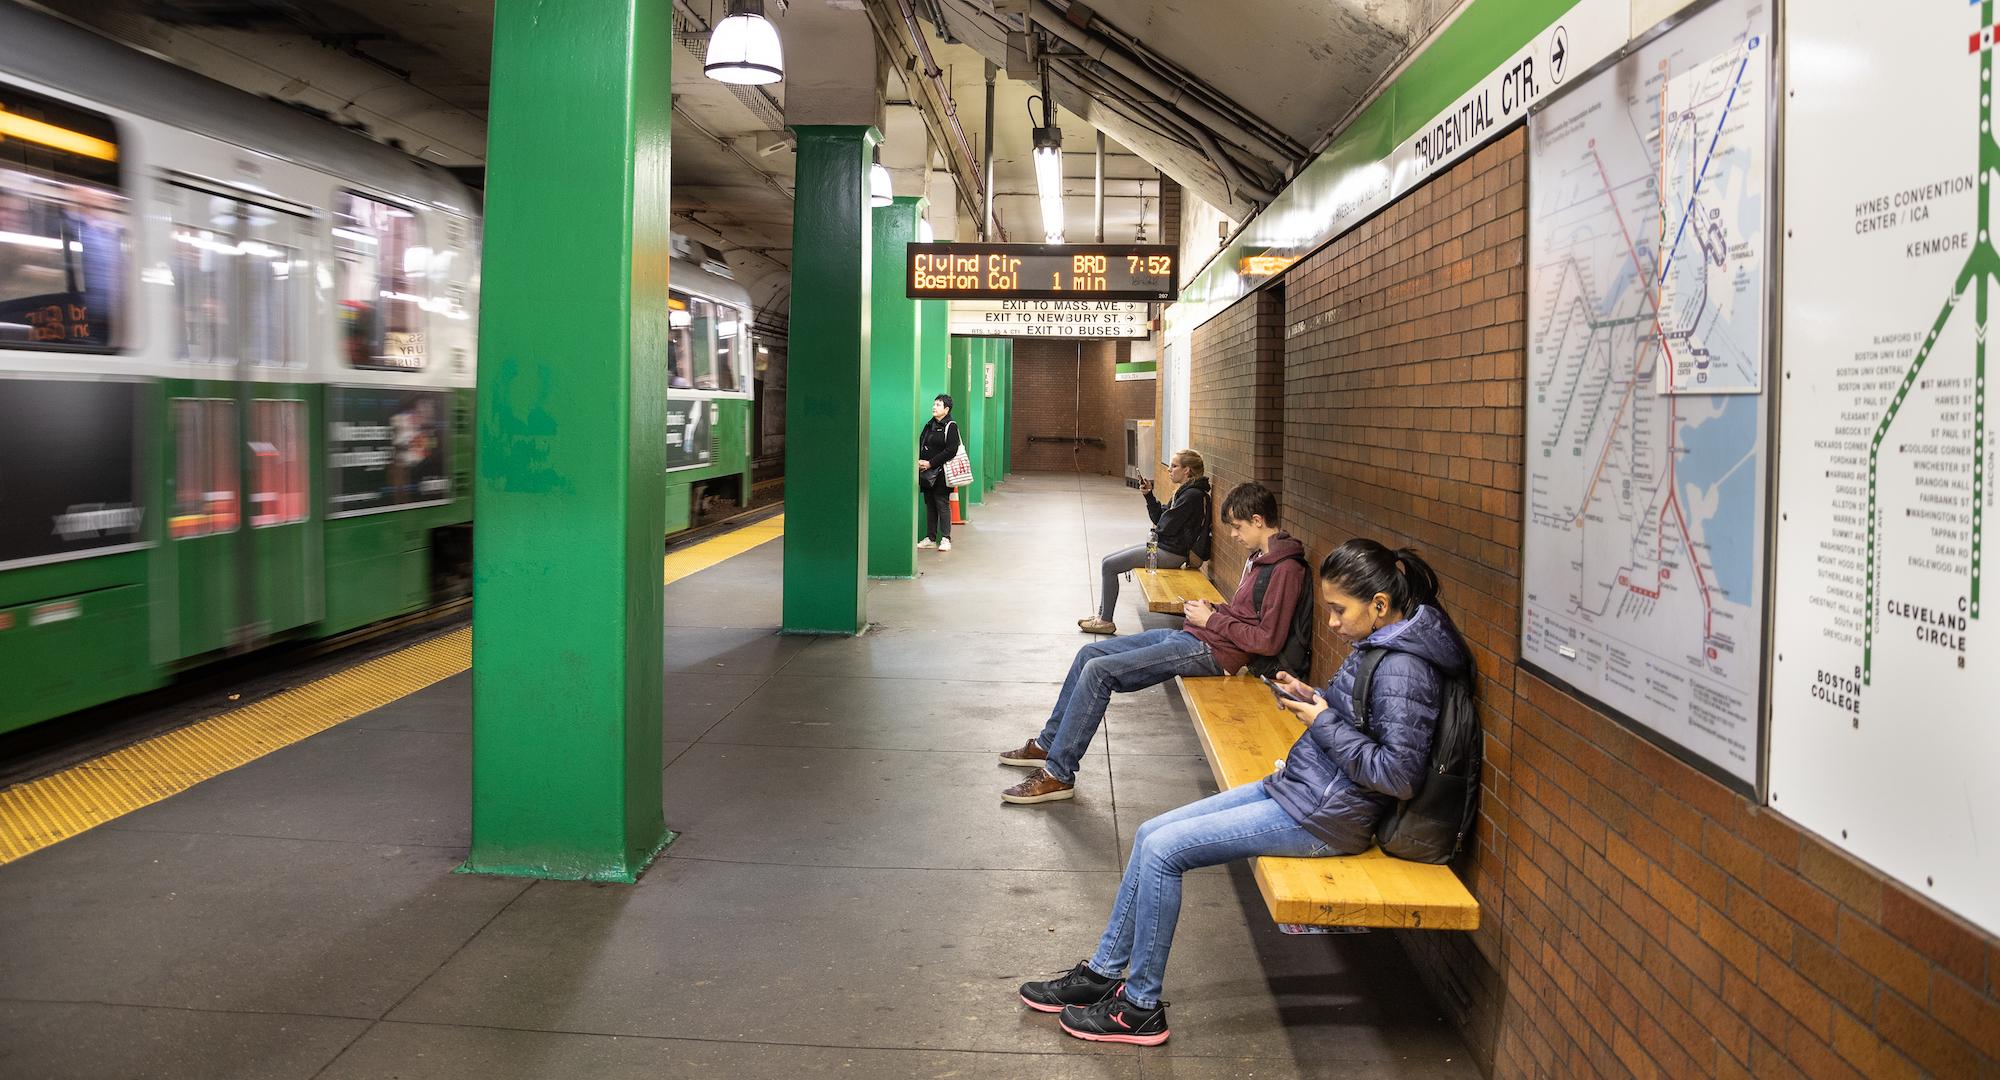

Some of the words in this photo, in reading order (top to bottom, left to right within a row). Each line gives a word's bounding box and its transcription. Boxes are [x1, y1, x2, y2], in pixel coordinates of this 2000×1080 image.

[1415, 89, 1493, 176] PRUDENTIAL
[1502, 56, 1539, 115] CTR.
[1855, 195, 1890, 217] HYNES
[1894, 174, 1974, 208] CONVENTION
[1855, 211, 1897, 235] CENTER
[1910, 204, 1929, 223] ICA
[1906, 232, 1969, 259] KENMORE
[914, 254, 979, 272] Clvlnd
[988, 254, 1022, 273] Cir
[1073, 255, 1107, 274] BRD
[1127, 255, 1171, 275] 7:52
[914, 271, 979, 289] Boston
[988, 271, 1017, 289] Col
[1052, 271, 1062, 290] 1
[1073, 272, 1107, 291] min
[1002, 301, 1027, 310] EXIT
[1033, 301, 1048, 310] TO
[1054, 301, 1091, 311] MASS.
[1095, 301, 1121, 311] AVE.
[985, 312, 1010, 322] EXIT
[1017, 312, 1032, 322] TO
[1038, 313, 1098, 323] NEWBURY
[1104, 314, 1121, 323] ST.
[1027, 326, 1051, 335] EXIT
[1057, 326, 1073, 335] TO
[1079, 326, 1121, 336] BUSES
[1873, 333, 1911, 345] BLANDFORD
[1913, 332, 1922, 341] ST
[1854, 351, 1878, 361] BOSTON
[1880, 350, 1895, 359] UNIV
[1896, 348, 1913, 358] EAST
[1836, 367, 1859, 377] BOSTON
[1876, 366, 1904, 375] CENTRAL
[1838, 382, 1860, 391] BOSTON
[1862, 381, 1876, 390] UNIV
[1878, 381, 1896, 390] WEST
[1937, 379, 1960, 388] MARYS
[1963, 378, 1972, 387] ST
[1963, 395, 1972, 404] ST
[1871, 412, 1879, 421] ST
[1940, 412, 1959, 421] KENT
[1963, 412, 1971, 422] ST
[1864, 427, 1871, 436] ST
[1931, 428, 1939, 438] ST
[1942, 429, 1959, 438] PAUL
[1962, 429, 1971, 438] ST
[1988, 431, 1995, 446] ST
[1903, 444, 1938, 454] COOLIDGE
[1941, 445, 1971, 455] CORNER
[1913, 461, 1959, 472] WINCHESTER
[1961, 463, 1970, 473] ST
[1915, 477, 1949, 488] BRANDON
[1951, 480, 1969, 491] HALL
[1987, 451, 1995, 507] BEACON
[1859, 487, 1866, 496] ST
[1832, 500, 1857, 510] ALLSTON
[1858, 502, 1866, 511] ST
[1919, 492, 1957, 506] FAIRBANKS
[1960, 498, 1969, 507] ST
[1858, 517, 1865, 526] ST
[1910, 509, 1956, 523] WASHINGTON
[1930, 526, 1957, 540] TAPPAN
[1959, 530, 1969, 541] ST
[1857, 547, 1865, 556] ST
[1935, 544, 1955, 557] DEAN
[1908, 556, 1953, 573] ENGLEWOOD
[1954, 563, 1968, 577] AVE
[1817, 569, 1854, 585] SUTHERLAND
[1958, 596, 1967, 612] C
[1852, 605, 1863, 617] AVE
[1887, 599, 1967, 632] CLEVELAND
[1834, 616, 1853, 629] SOUTH
[1855, 619, 1863, 631] ST
[1916, 625, 1966, 653] CIRCLE
[1854, 665, 1861, 679] B
[1817, 669, 1861, 697] BOSTON
[1811, 684, 1860, 714] COLLEGE
